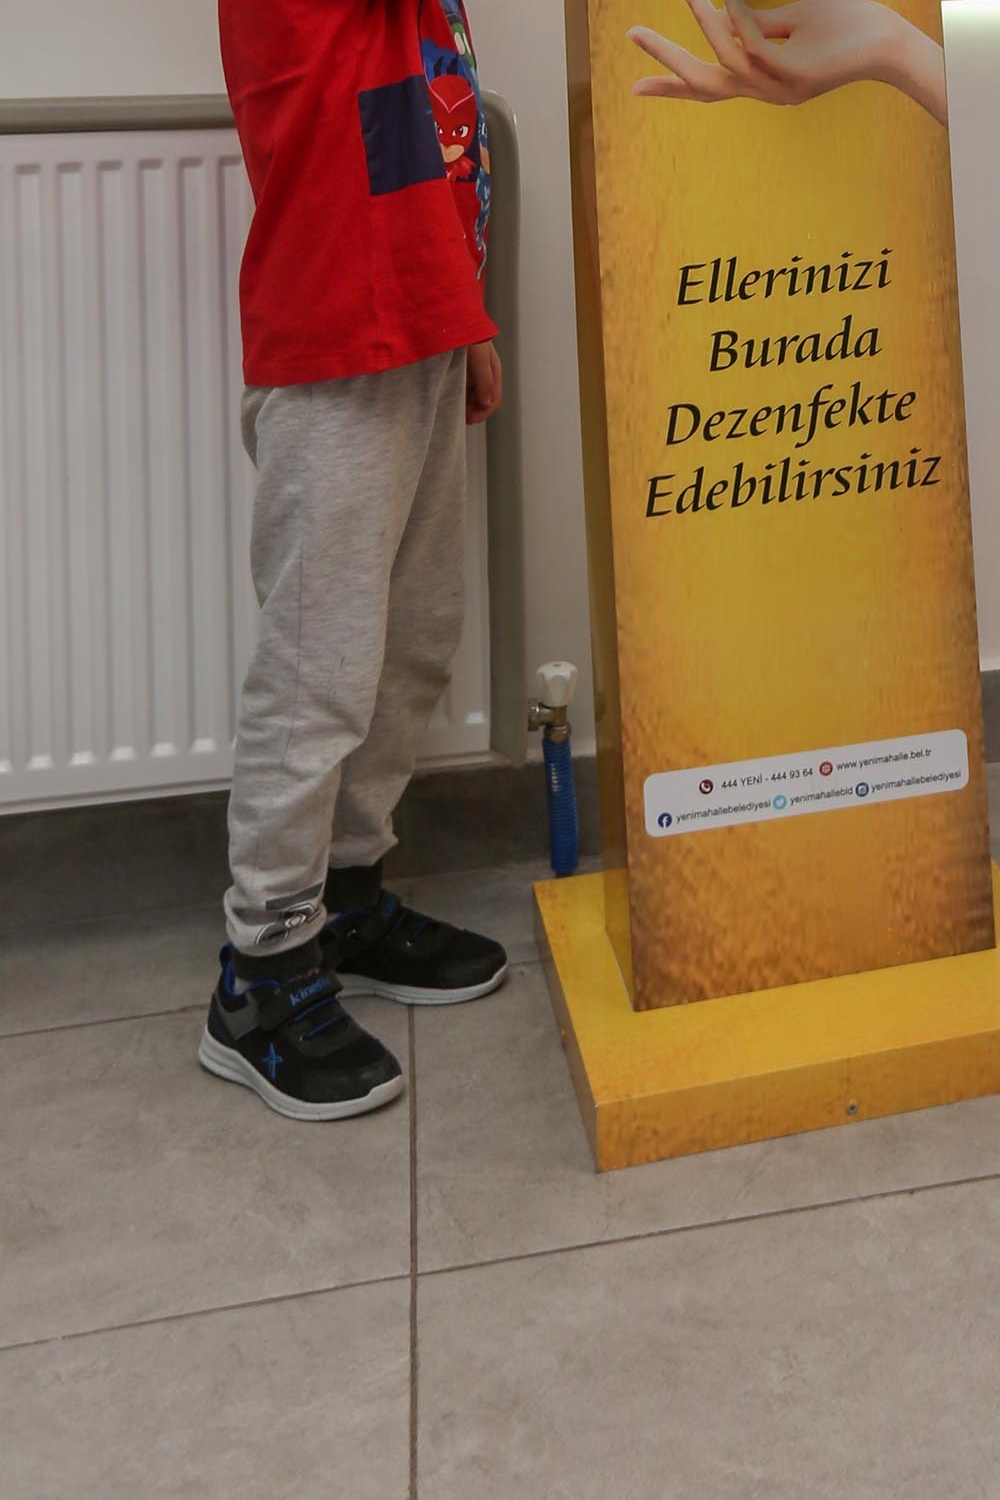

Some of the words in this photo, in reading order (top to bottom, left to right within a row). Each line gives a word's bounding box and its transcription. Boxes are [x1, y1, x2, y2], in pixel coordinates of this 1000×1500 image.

[676, 247, 894, 306] Ellerinizi
[709, 314, 883, 372] Burada
[665, 381, 918, 448] Dezenfekte
[645, 447, 943, 518] Edebilirsiniz
[721, 779, 738, 790] 444
[739, 774, 763, 787] YENİ
[770, 771, 787, 782] 444
[789, 769, 801, 780] 93
[802, 767, 814, 777] 64
[836, 748, 932, 771] www.yenimahalle.bel.tr
[871, 770, 962, 794] yenimahallebelediyesi
[675, 800, 772, 825] yenimahallebelediyesi
